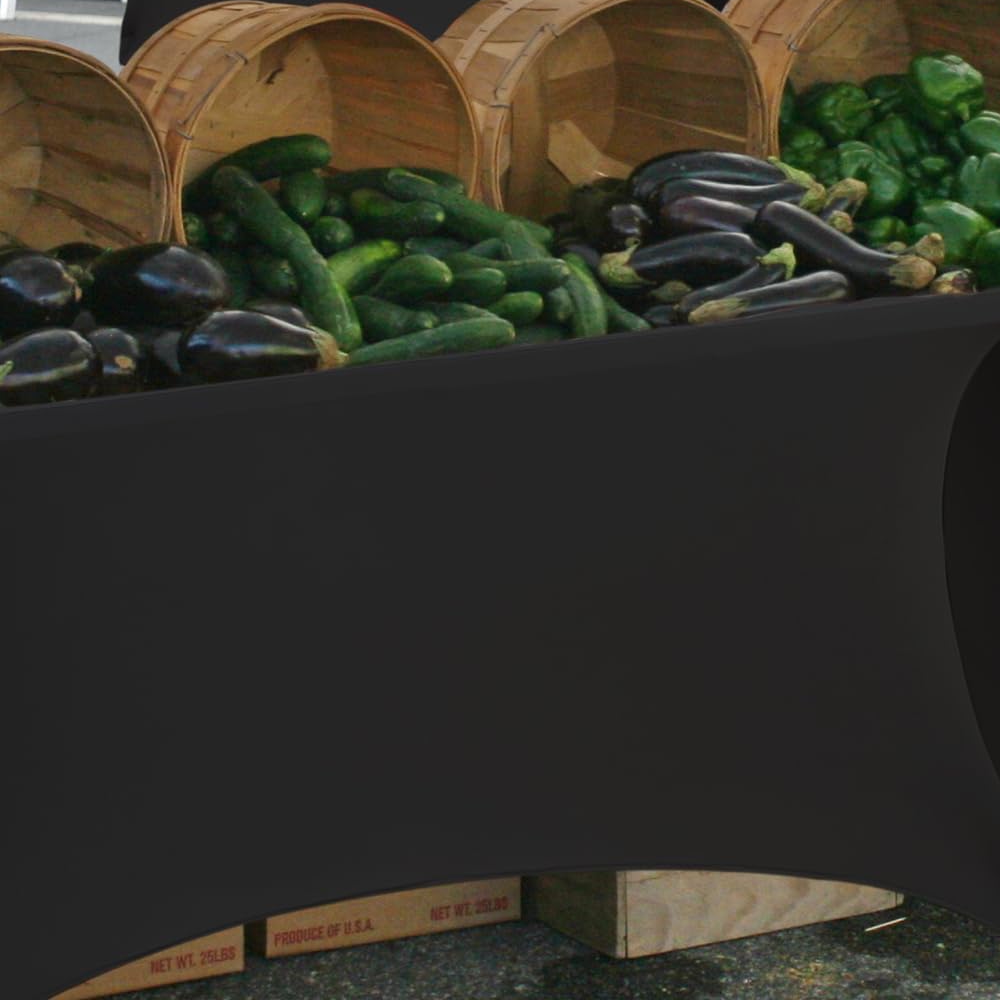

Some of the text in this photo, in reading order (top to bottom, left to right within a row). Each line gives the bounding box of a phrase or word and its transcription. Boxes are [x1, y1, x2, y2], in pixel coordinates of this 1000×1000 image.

[431, 904, 450, 921] NET
[273, 926, 324, 947] PRODUCE
[326, 921, 342, 939] OF
[150, 957, 172, 975] NET
[200, 946, 236, 966] 25LBS
